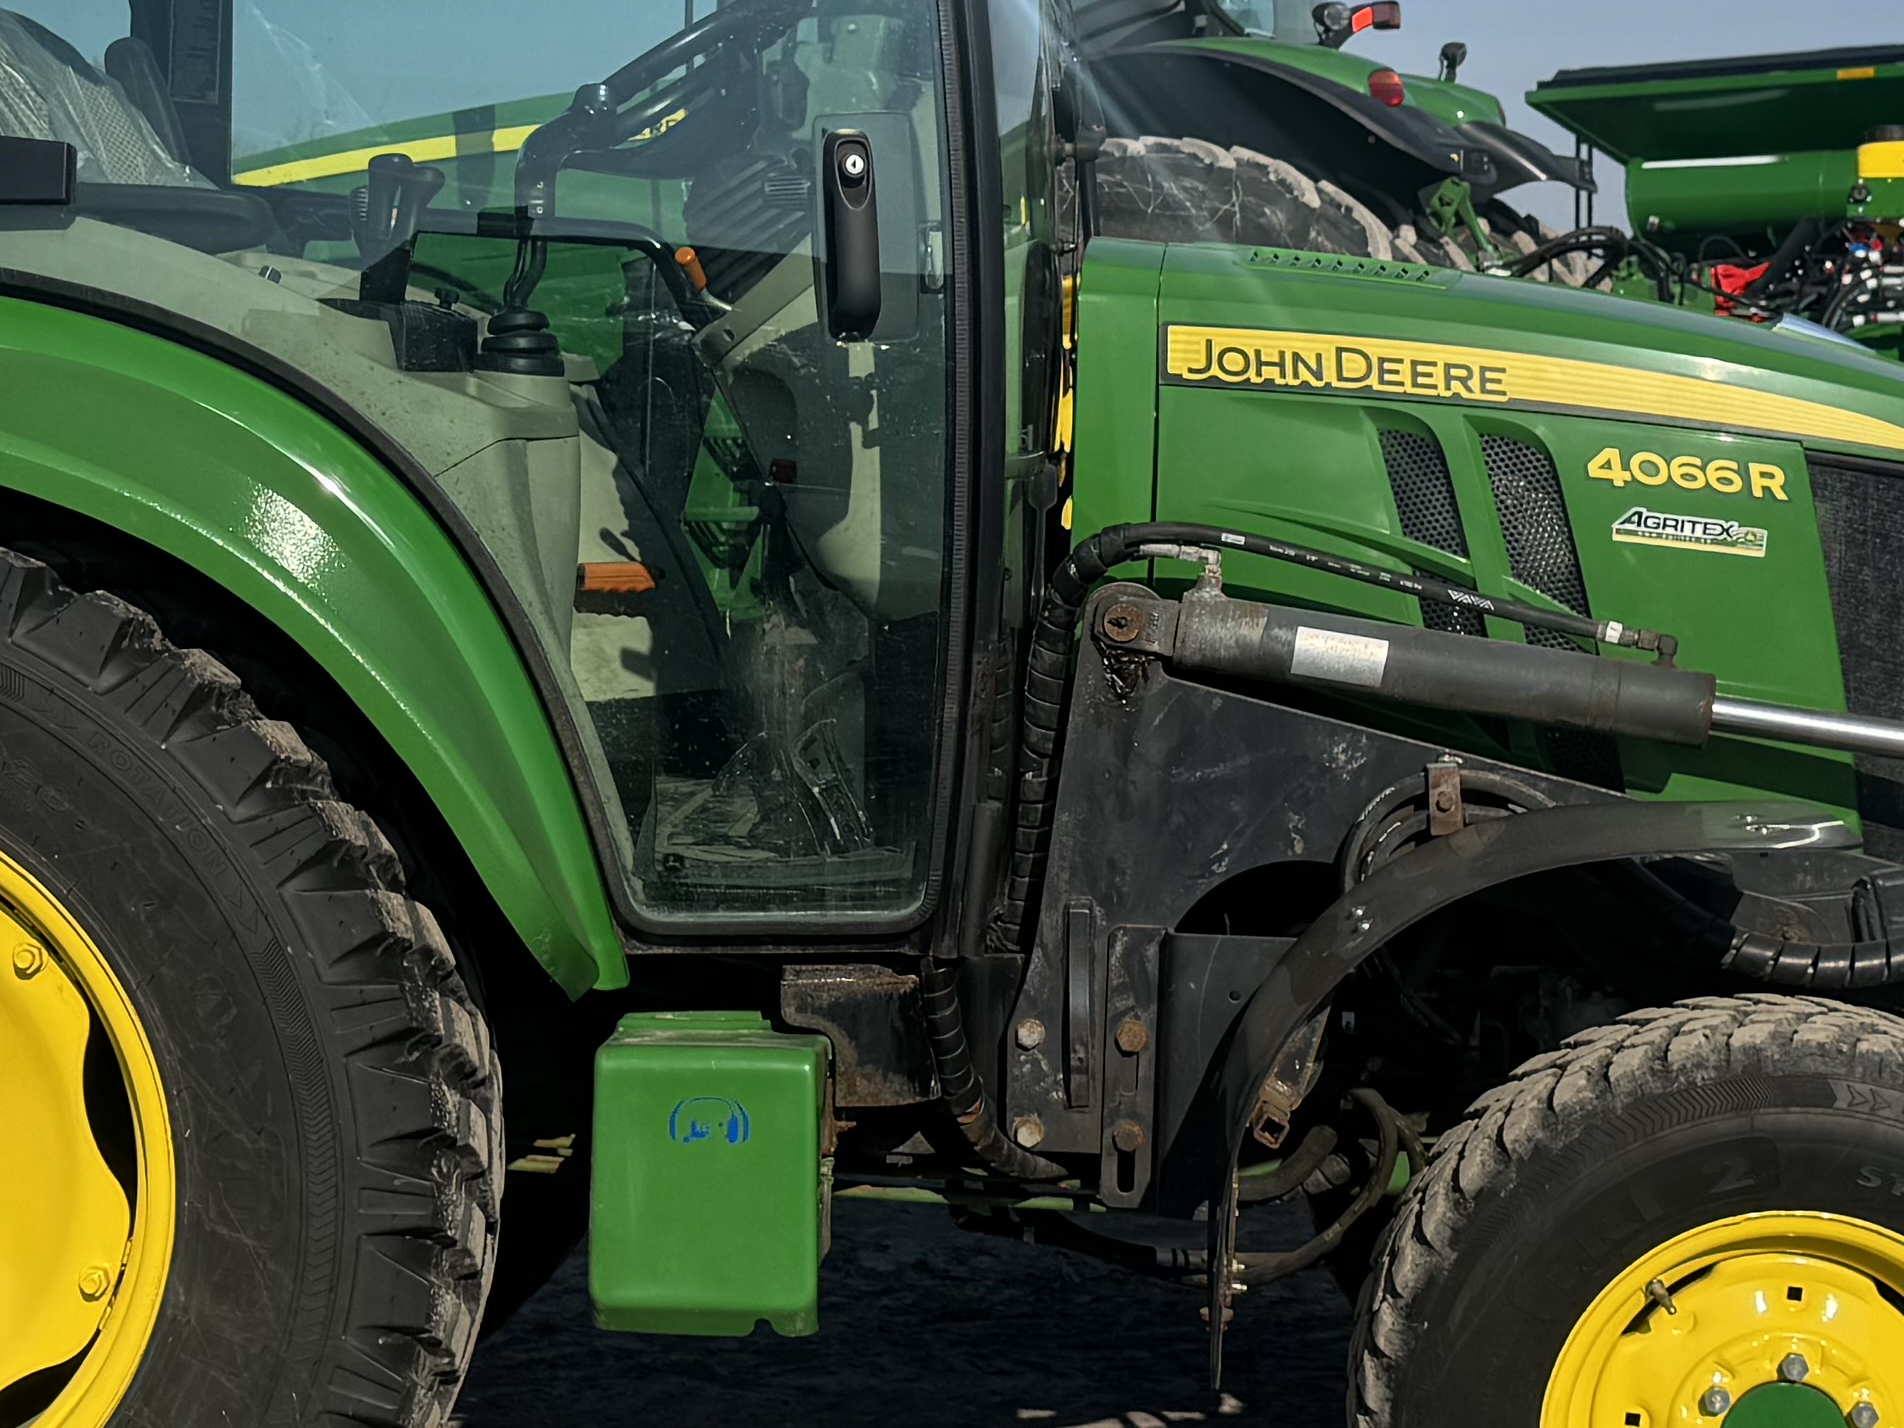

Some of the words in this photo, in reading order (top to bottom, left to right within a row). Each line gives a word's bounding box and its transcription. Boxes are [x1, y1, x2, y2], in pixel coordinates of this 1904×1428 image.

[1187, 339, 1324, 383] JOHN
[1335, 347, 1508, 397] DEERE
[1617, 510, 1736, 539] AGRITEX
